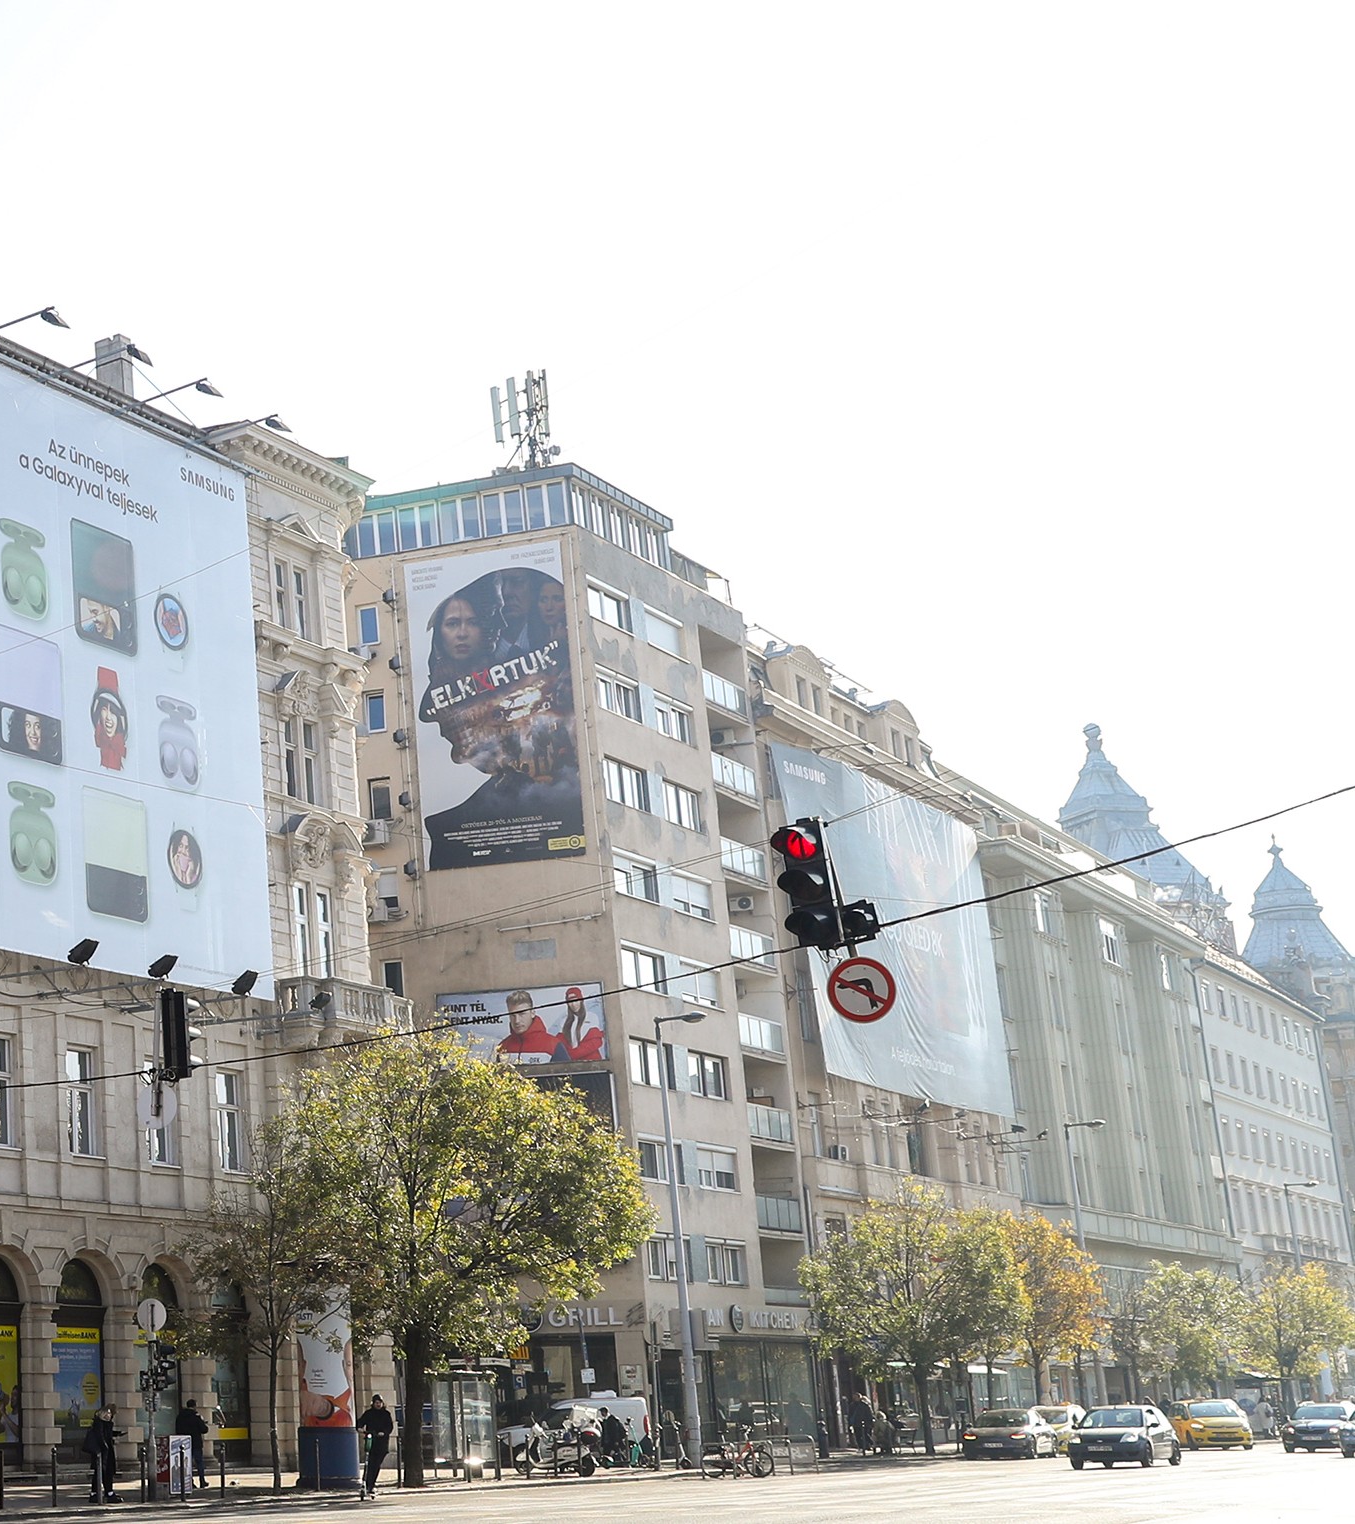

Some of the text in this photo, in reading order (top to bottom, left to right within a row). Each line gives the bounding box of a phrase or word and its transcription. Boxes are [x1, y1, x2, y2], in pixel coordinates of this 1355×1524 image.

[48, 438, 130, 488] Az ünnepek
[19, 453, 158, 524] a Galaxyval teljesek
[180, 466, 235, 502] SAMSUNG
[783, 760, 827, 785] SAMSUNG
[471, 1000, 486, 1012] TÉL
[548, 1307, 624, 1327] GRILL
[750, 1311, 799, 1330] KITCHEN
